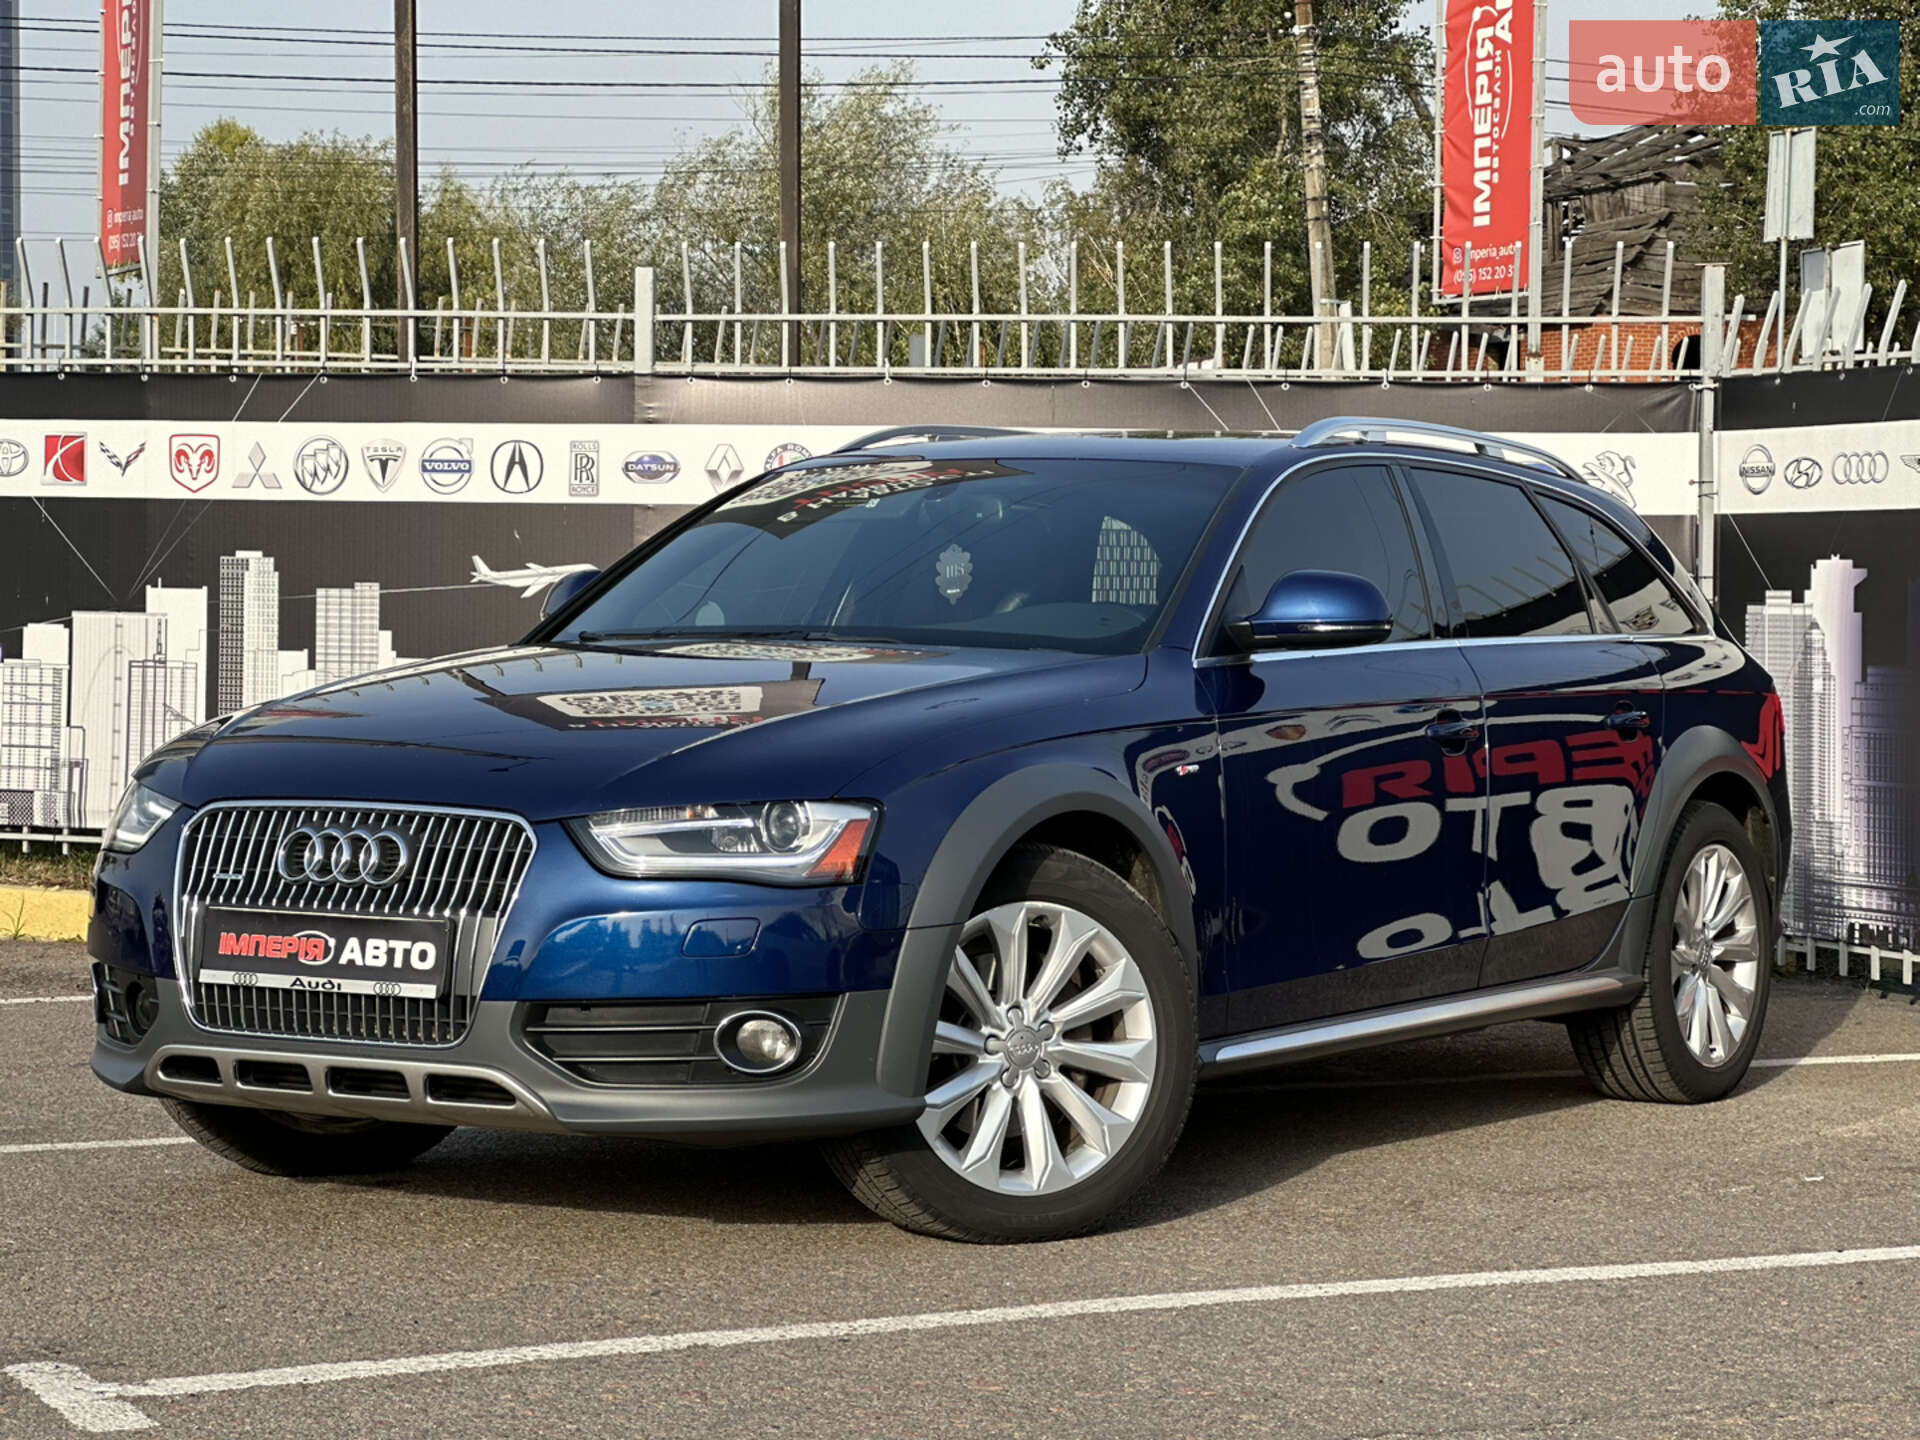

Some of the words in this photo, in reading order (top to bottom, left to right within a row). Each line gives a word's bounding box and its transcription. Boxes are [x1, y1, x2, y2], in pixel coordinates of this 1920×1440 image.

[1473, 25, 1494, 227] ІМПЕРІЯ
[1494, 265, 1506, 280] 20
[423, 462, 470, 471] VOLVO
[628, 463, 675, 472] DATSUN
[1743, 465, 1773, 474] NISSAN
[218, 932, 326, 961] ІМПЕРІЯ
[338, 937, 437, 970] АВТО
[289, 977, 342, 991] Audi
